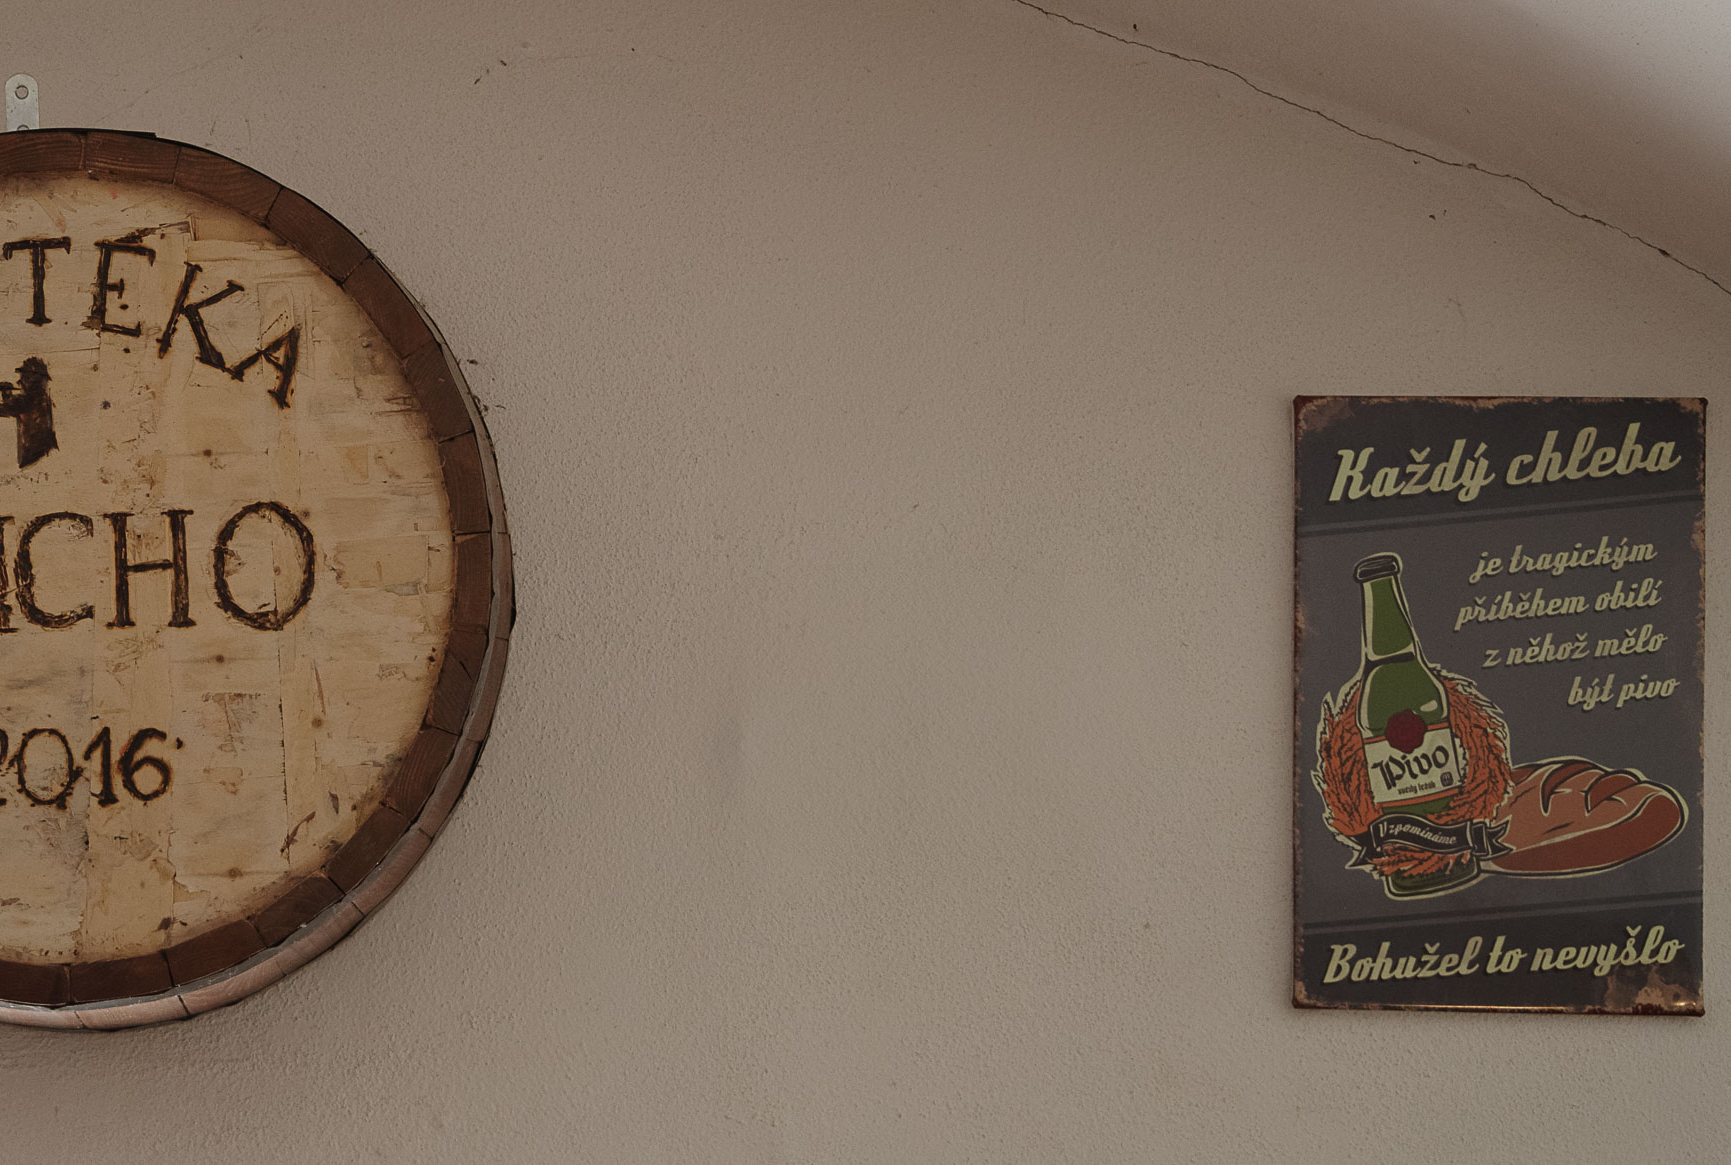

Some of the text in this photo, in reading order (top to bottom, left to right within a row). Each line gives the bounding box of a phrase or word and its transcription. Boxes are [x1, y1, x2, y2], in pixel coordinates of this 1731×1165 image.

[1329, 422, 1681, 502] Každý chleba
[1469, 536, 1658, 584] je tragickým
[1454, 578, 1663, 631] příběhem obilí
[1482, 624, 1668, 668] z něhož mělo
[1567, 673, 1680, 712] být pivo
[1371, 746, 1449, 790] Pivo
[1378, 820, 1457, 845] Vzpomínáme
[1323, 925, 1685, 984] Bohužel to nevyšlo
